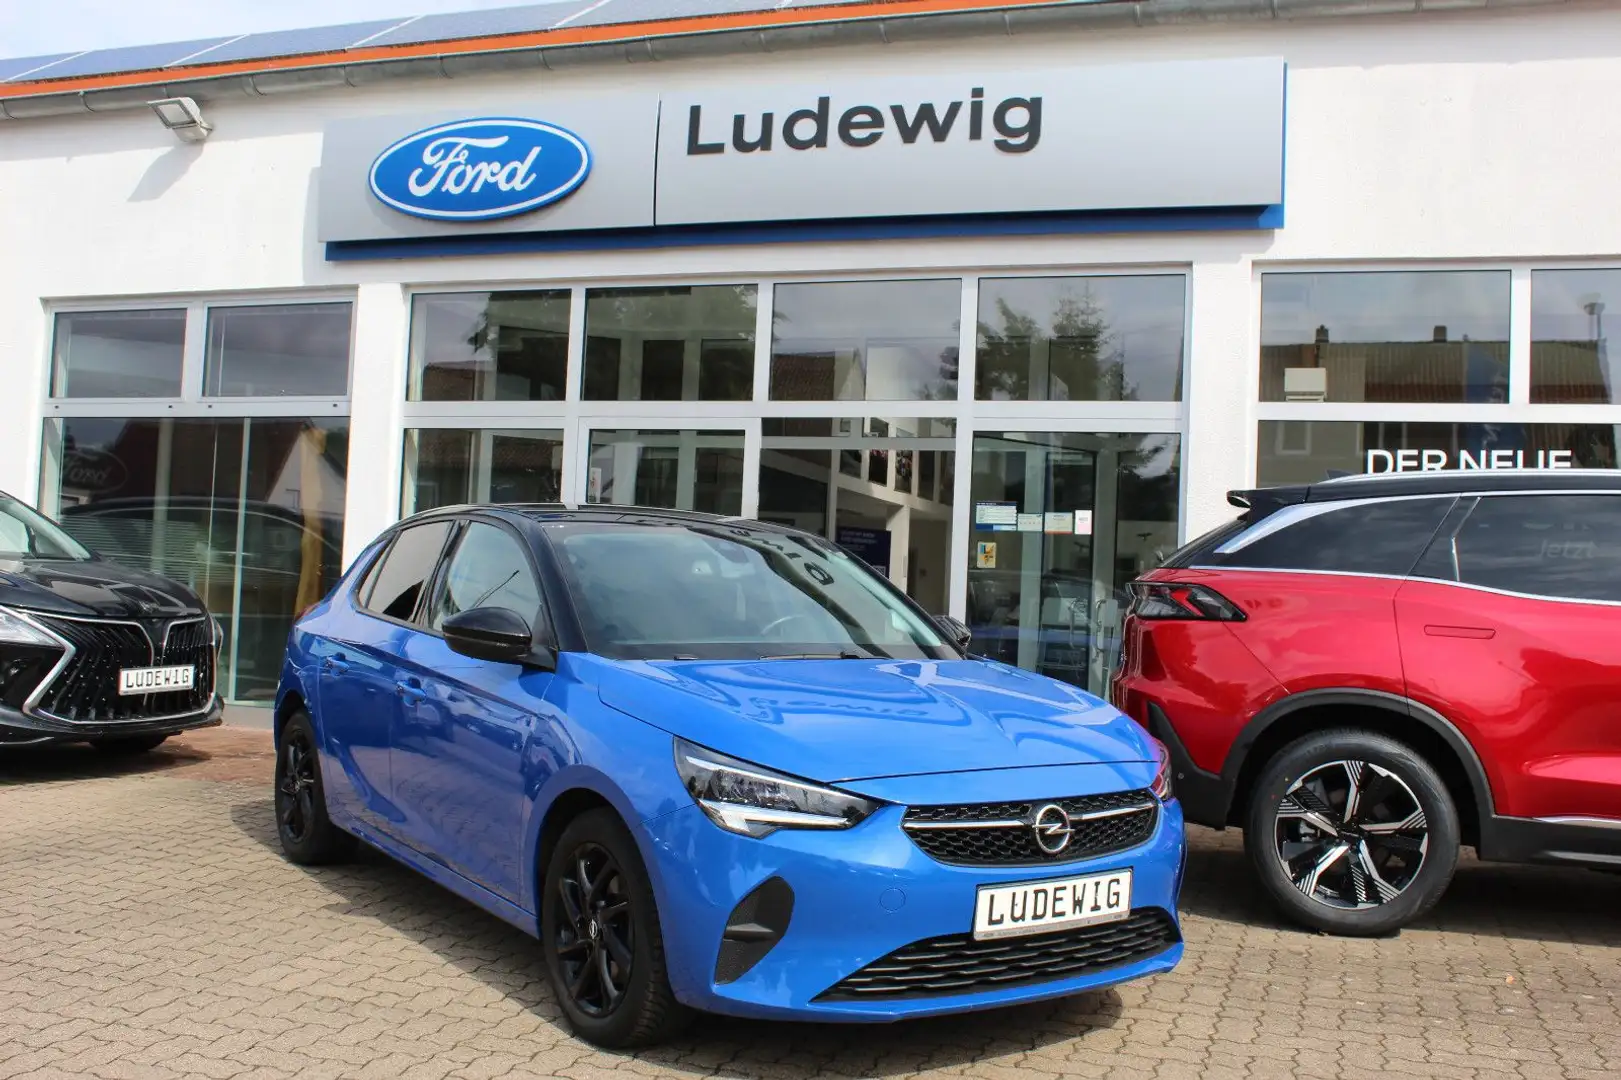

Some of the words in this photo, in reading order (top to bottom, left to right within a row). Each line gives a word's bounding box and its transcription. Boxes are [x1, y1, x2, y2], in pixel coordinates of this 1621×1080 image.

[686, 87, 1043, 155] Ludewig
[408, 135, 543, 197] Ford
[1366, 449, 1447, 474] DER
[125, 668, 190, 688] LUDEWIG
[987, 878, 1121, 926] LUDEWIG
